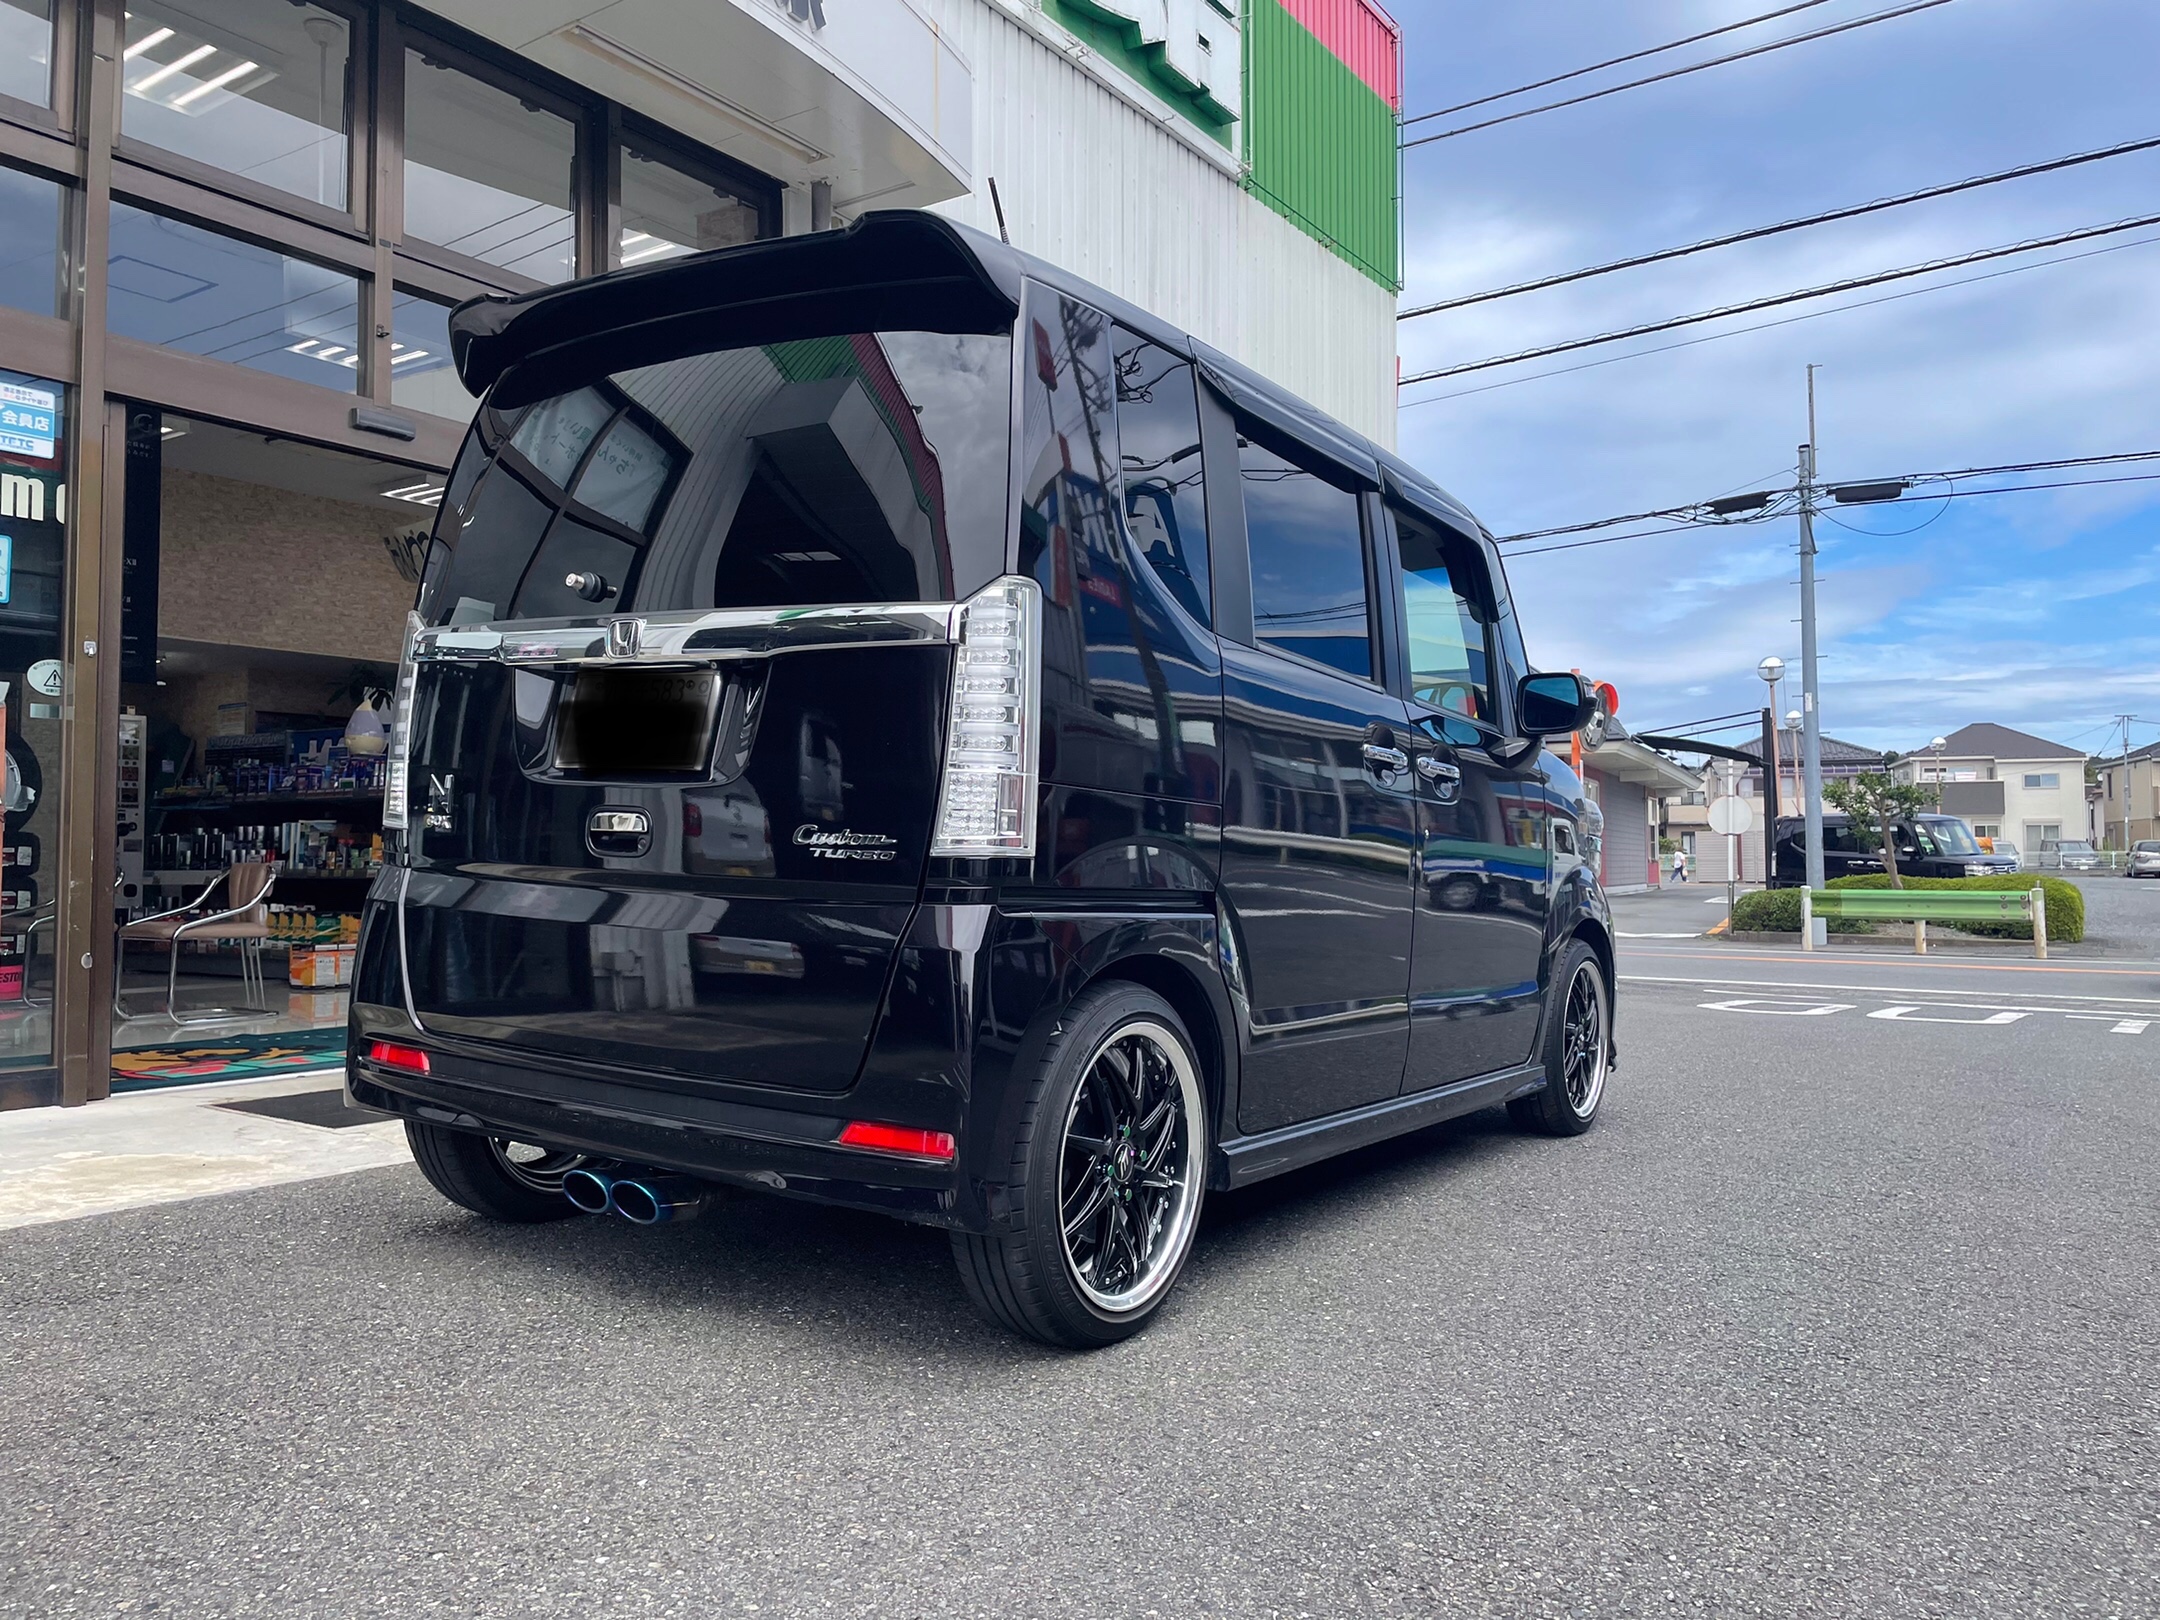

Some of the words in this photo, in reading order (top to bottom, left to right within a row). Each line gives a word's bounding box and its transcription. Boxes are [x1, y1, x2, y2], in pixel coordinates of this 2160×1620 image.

[2, 409, 50, 432] 会員店
[792, 824, 899, 846] Custom
[809, 847, 898, 862] TURBO
